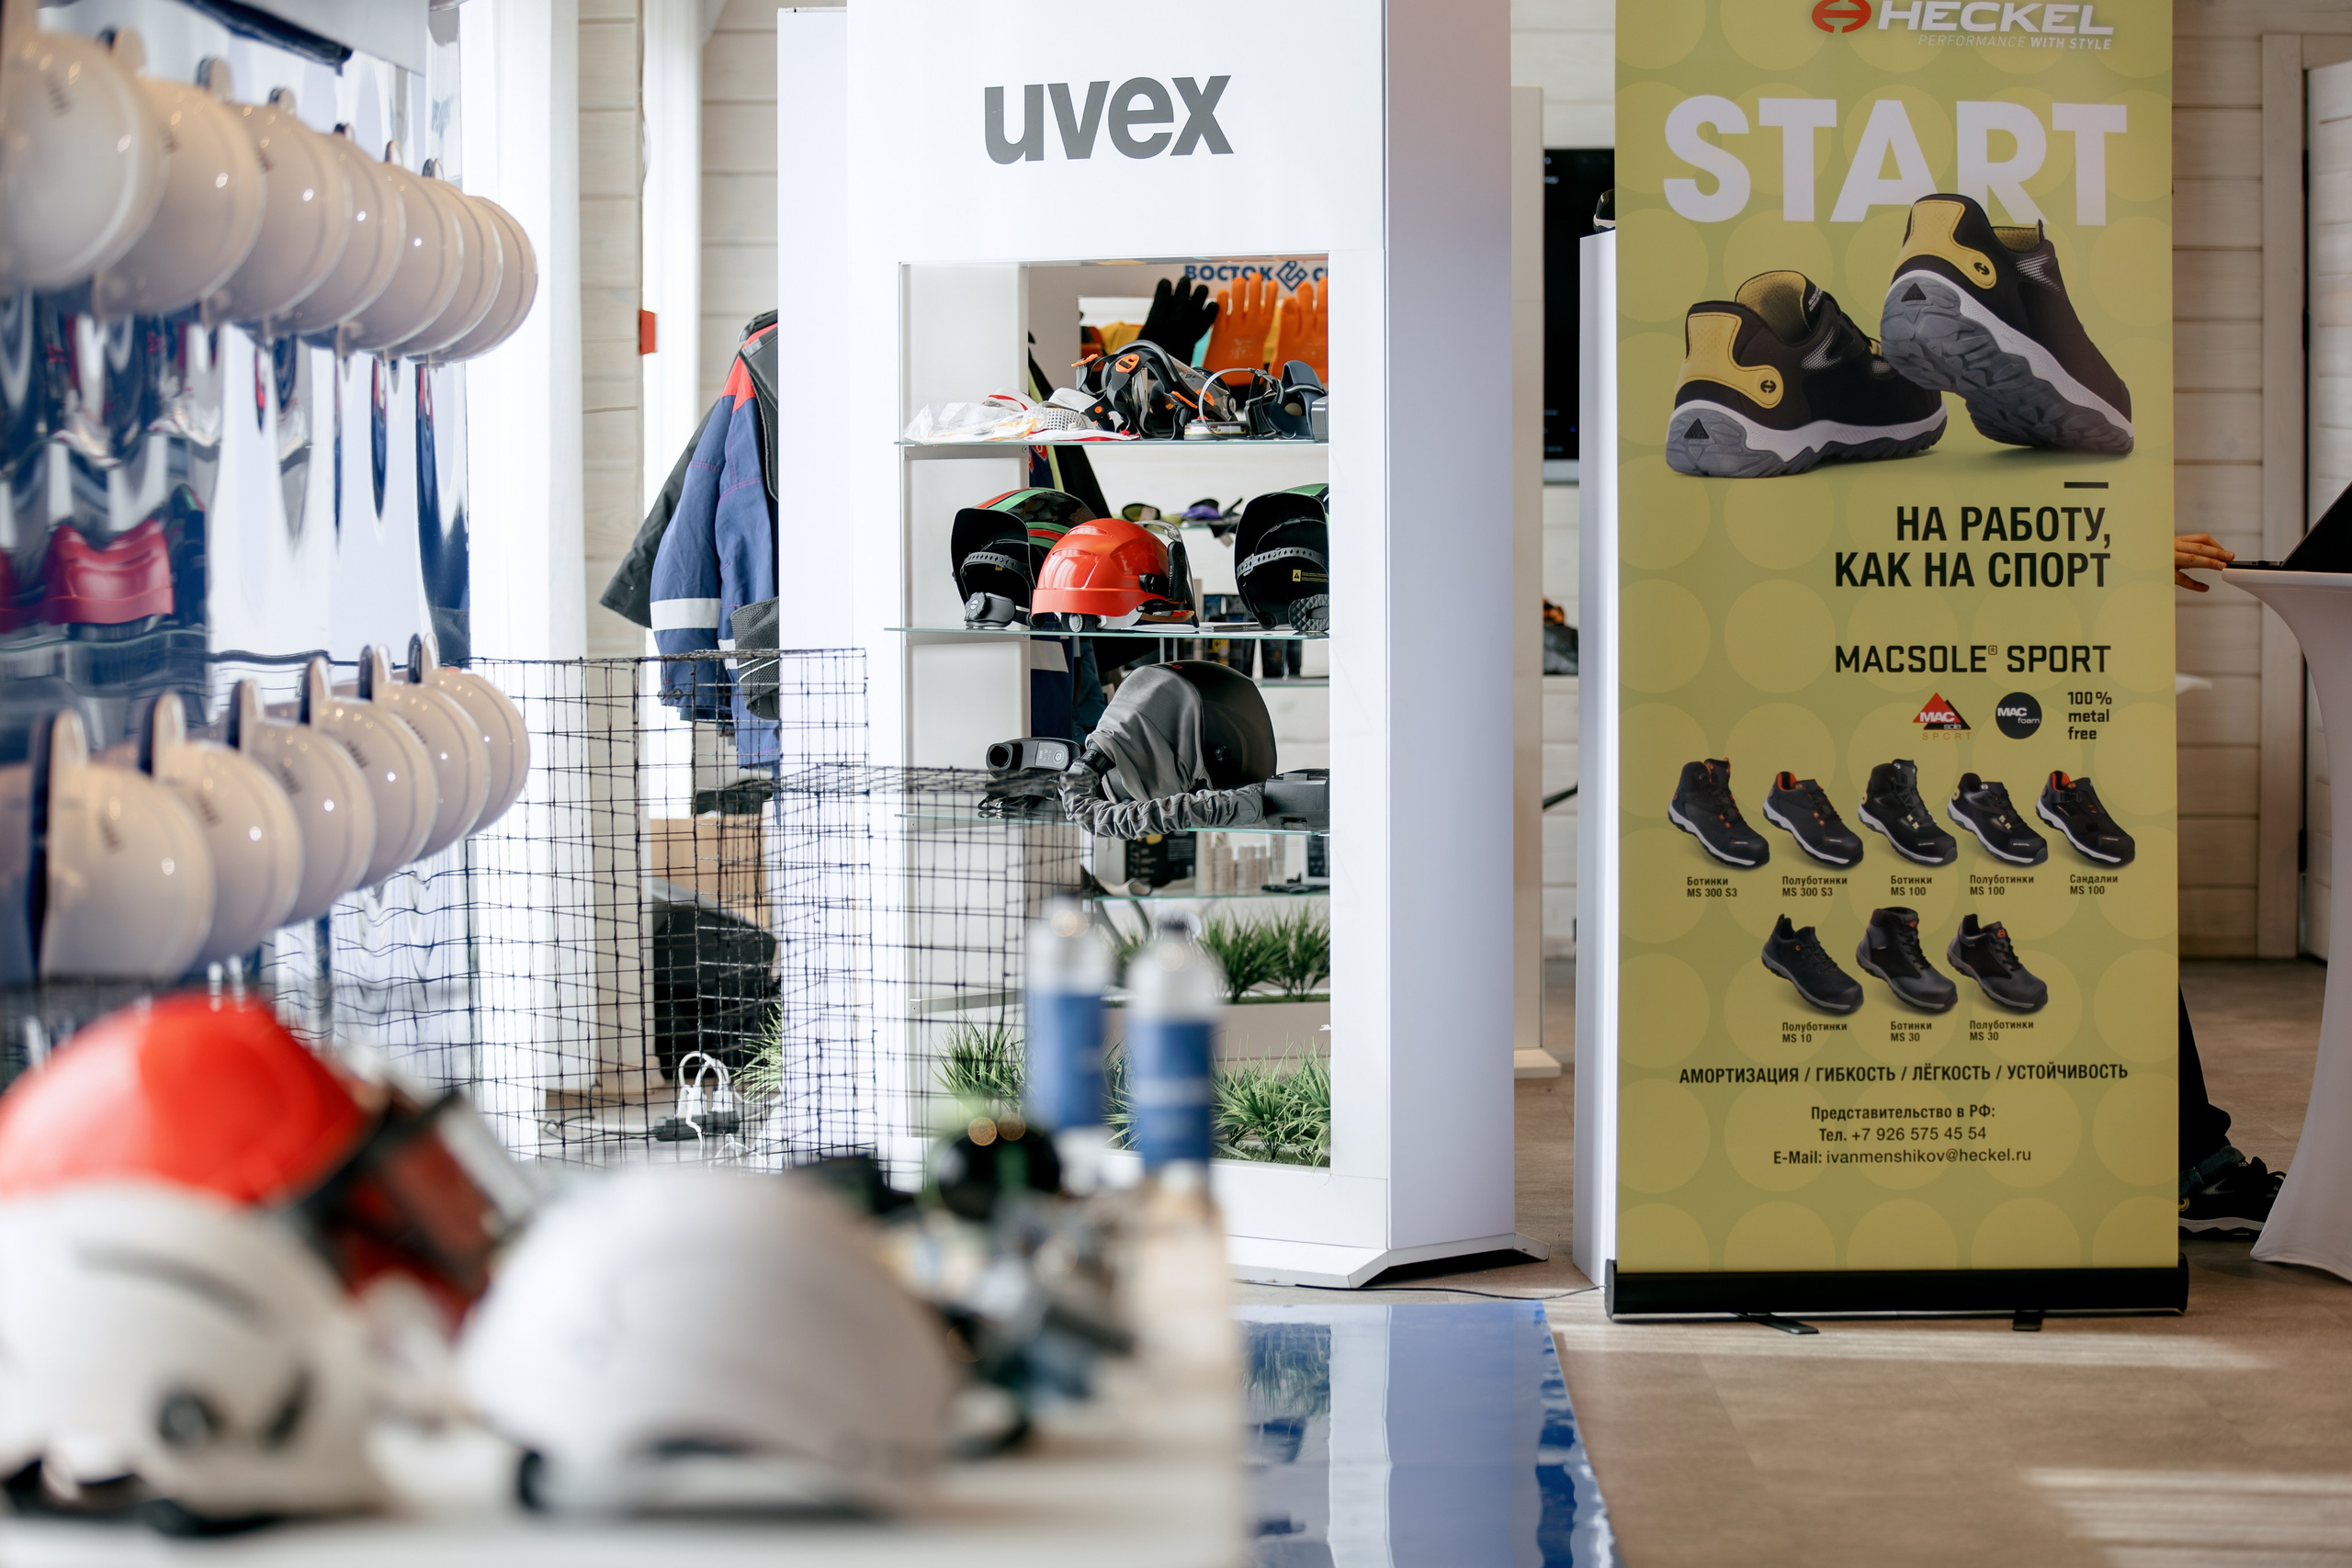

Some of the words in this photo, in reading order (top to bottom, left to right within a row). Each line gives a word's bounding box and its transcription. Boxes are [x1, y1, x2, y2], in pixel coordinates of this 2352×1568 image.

[1877, 0, 2114, 35] HECKEL
[1917, 34, 2026, 48] PERFORMANCE
[2030, 36, 2065, 49] WITH
[2068, 38, 2112, 51] STYLE
[984, 74, 1235, 165] uvex
[1663, 94, 2127, 226] START
[1896, 505, 1948, 542] НА
[1961, 505, 2110, 549] РАБОТУ,
[1835, 551, 1912, 588] КАК
[1924, 551, 1975, 588] НА
[1988, 551, 2111, 588] СПОРТ
[2007, 645, 2111, 673] SPORT
[1919, 711, 1955, 723] MAC
[1996, 706, 2028, 717] MAC
[2068, 708, 2109, 723] metal
[2017, 716, 2041, 725] foam
[1921, 732, 1972, 741] SPORT
[2067, 726, 2098, 740] free
[1687, 875, 1729, 886] Ботинки
[1781, 874, 1848, 887] Полуботинки
[1890, 874, 1933, 885] Ботинки
[1969, 874, 2034, 886] Полуботинки
[2069, 874, 2119, 885] Сандалии
[1686, 887, 1702, 897] MS
[1704, 887, 1723, 897] 300
[1724, 887, 1738, 897] S3
[1781, 886, 1798, 897] MS
[1800, 886, 1818, 897] 300
[1820, 886, 1834, 897] S3
[1890, 886, 1905, 897] MS
[1908, 886, 1927, 897] 100
[1969, 886, 1984, 896] MS
[1987, 886, 2006, 896] 100
[2069, 885, 2086, 896] MS
[2087, 885, 2106, 896] 100
[1781, 1021, 1848, 1033] Полуботинки
[1890, 1021, 1932, 1031] Ботинки
[1969, 1020, 2034, 1032] Полуботинки
[1781, 1032, 1797, 1043] MS
[1800, 1033, 1813, 1043] 10
[1890, 1032, 1905, 1043] MS
[1908, 1032, 1920, 1043] 30
[1969, 1031, 1984, 1042] MS
[1986, 1031, 1999, 1042] 30
[1679, 1067, 1799, 1086] АМОРТИЗАЦИЯ
[1815, 1066, 1896, 1082] ГИБКОСТЬ
[1911, 1063, 1991, 1081] ЛЁГКОСТЬ
[2007, 1061, 2129, 1080] УСТОЙЧИВОСТЬ
[1811, 1106, 1952, 1122] Представительство
[1956, 1107, 1965, 1118] в
[1969, 1103, 1996, 1118] РФ:
[1818, 1128, 1848, 1142] Тел.
[1851, 1127, 1871, 1142] +7
[1876, 1127, 1905, 1142] 926
[1910, 1126, 1939, 1141] 575
[1943, 1126, 1963, 1141] 45
[1968, 1126, 1987, 1140] 54
[1773, 1150, 1822, 1165] E-Mail:
[1826, 1147, 2031, 1164] ivanmenshikov@heckel.ru
